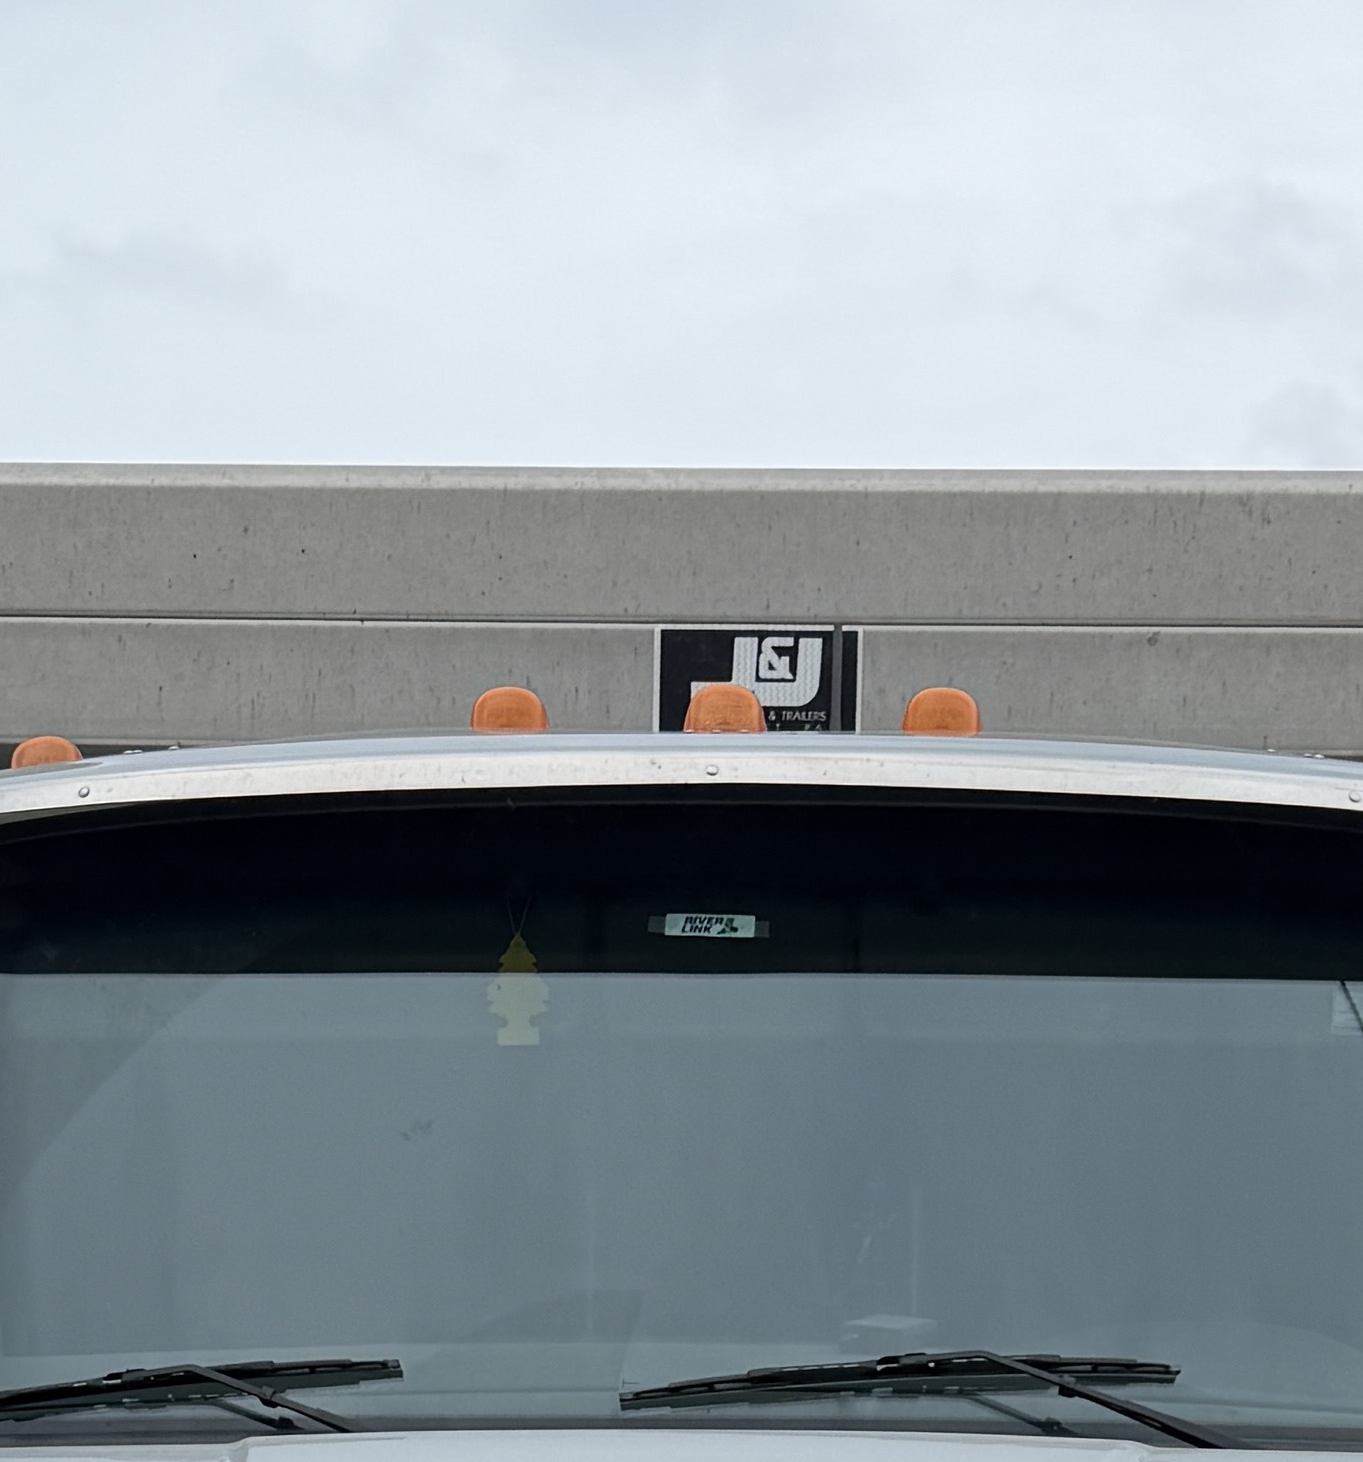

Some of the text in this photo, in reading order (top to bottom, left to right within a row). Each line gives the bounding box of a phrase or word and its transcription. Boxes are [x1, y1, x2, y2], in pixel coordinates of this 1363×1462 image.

[781, 710, 827, 722] TRAILERS
[684, 916, 725, 926] RIVER
[681, 924, 713, 934] LINK
